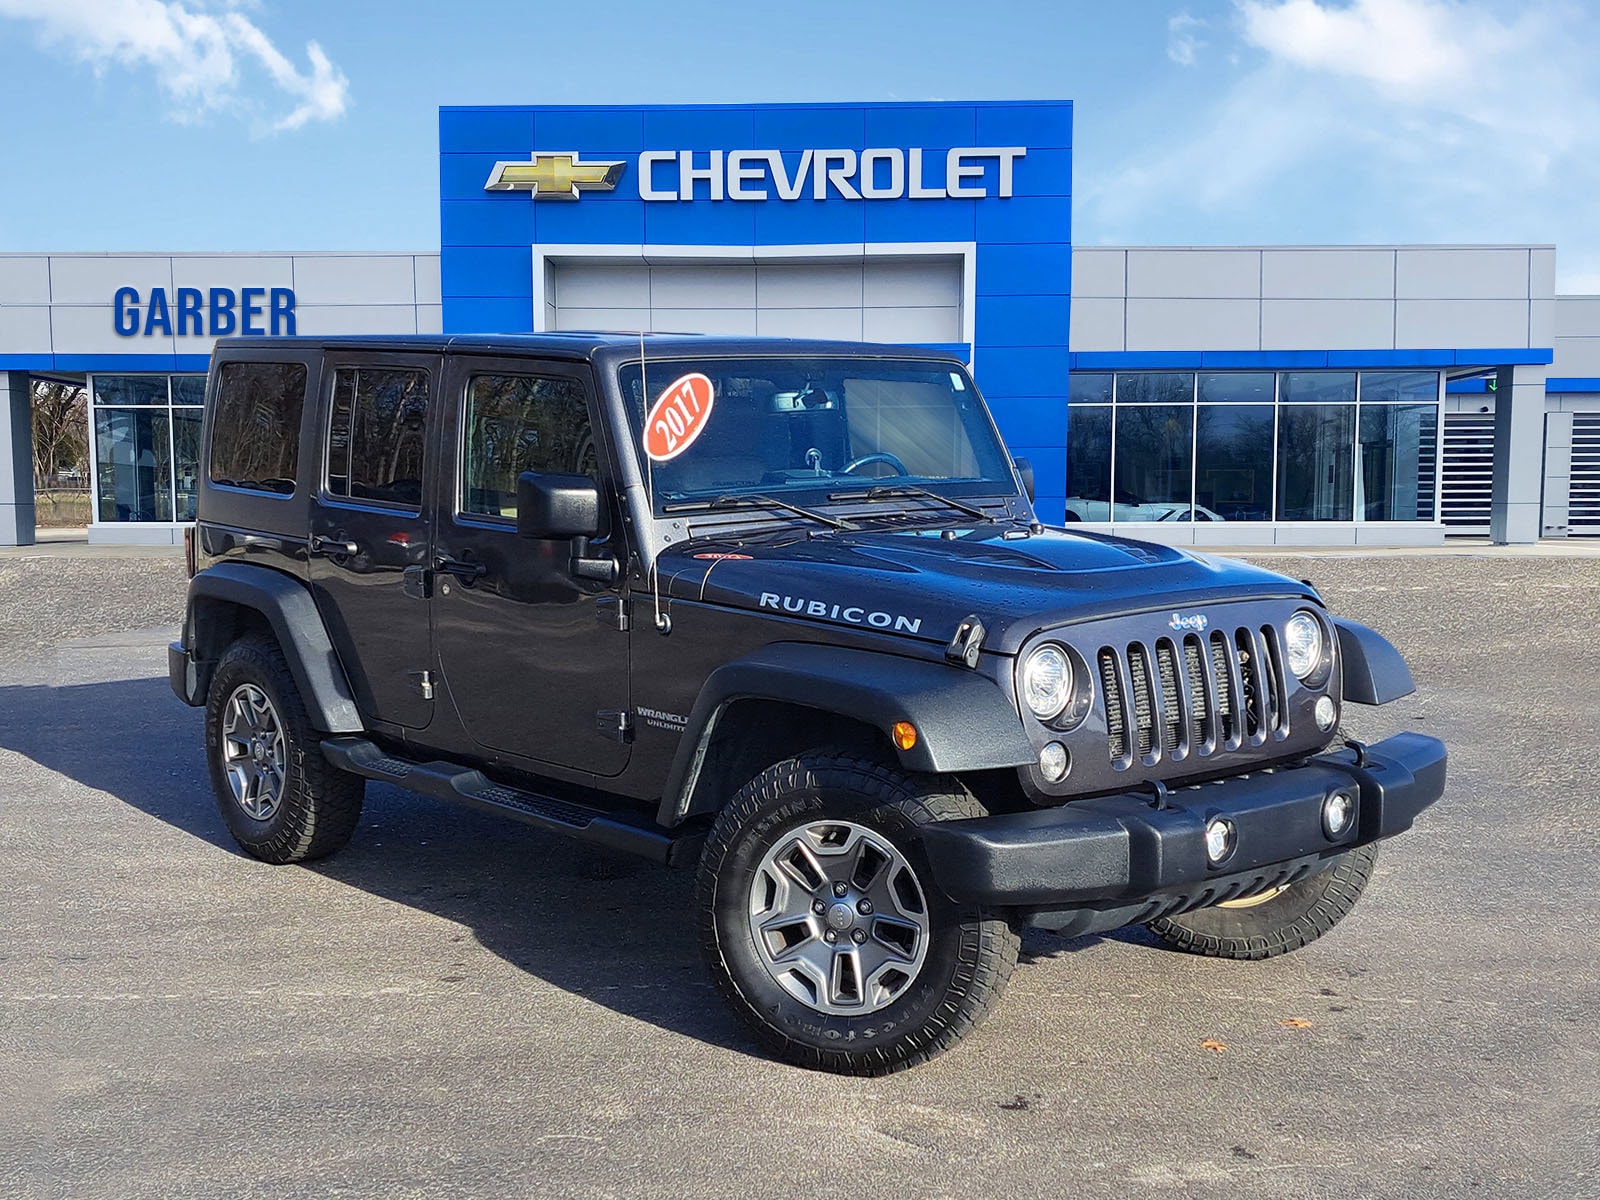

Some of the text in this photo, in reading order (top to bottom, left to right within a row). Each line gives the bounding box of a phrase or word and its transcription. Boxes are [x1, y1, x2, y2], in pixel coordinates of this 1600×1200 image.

[638, 146, 1027, 201] CHEVROLET
[114, 286, 297, 337] GARBER
[655, 380, 700, 452] 2017
[759, 592, 922, 633] RUBICON
[1168, 612, 1209, 631] Jeep
